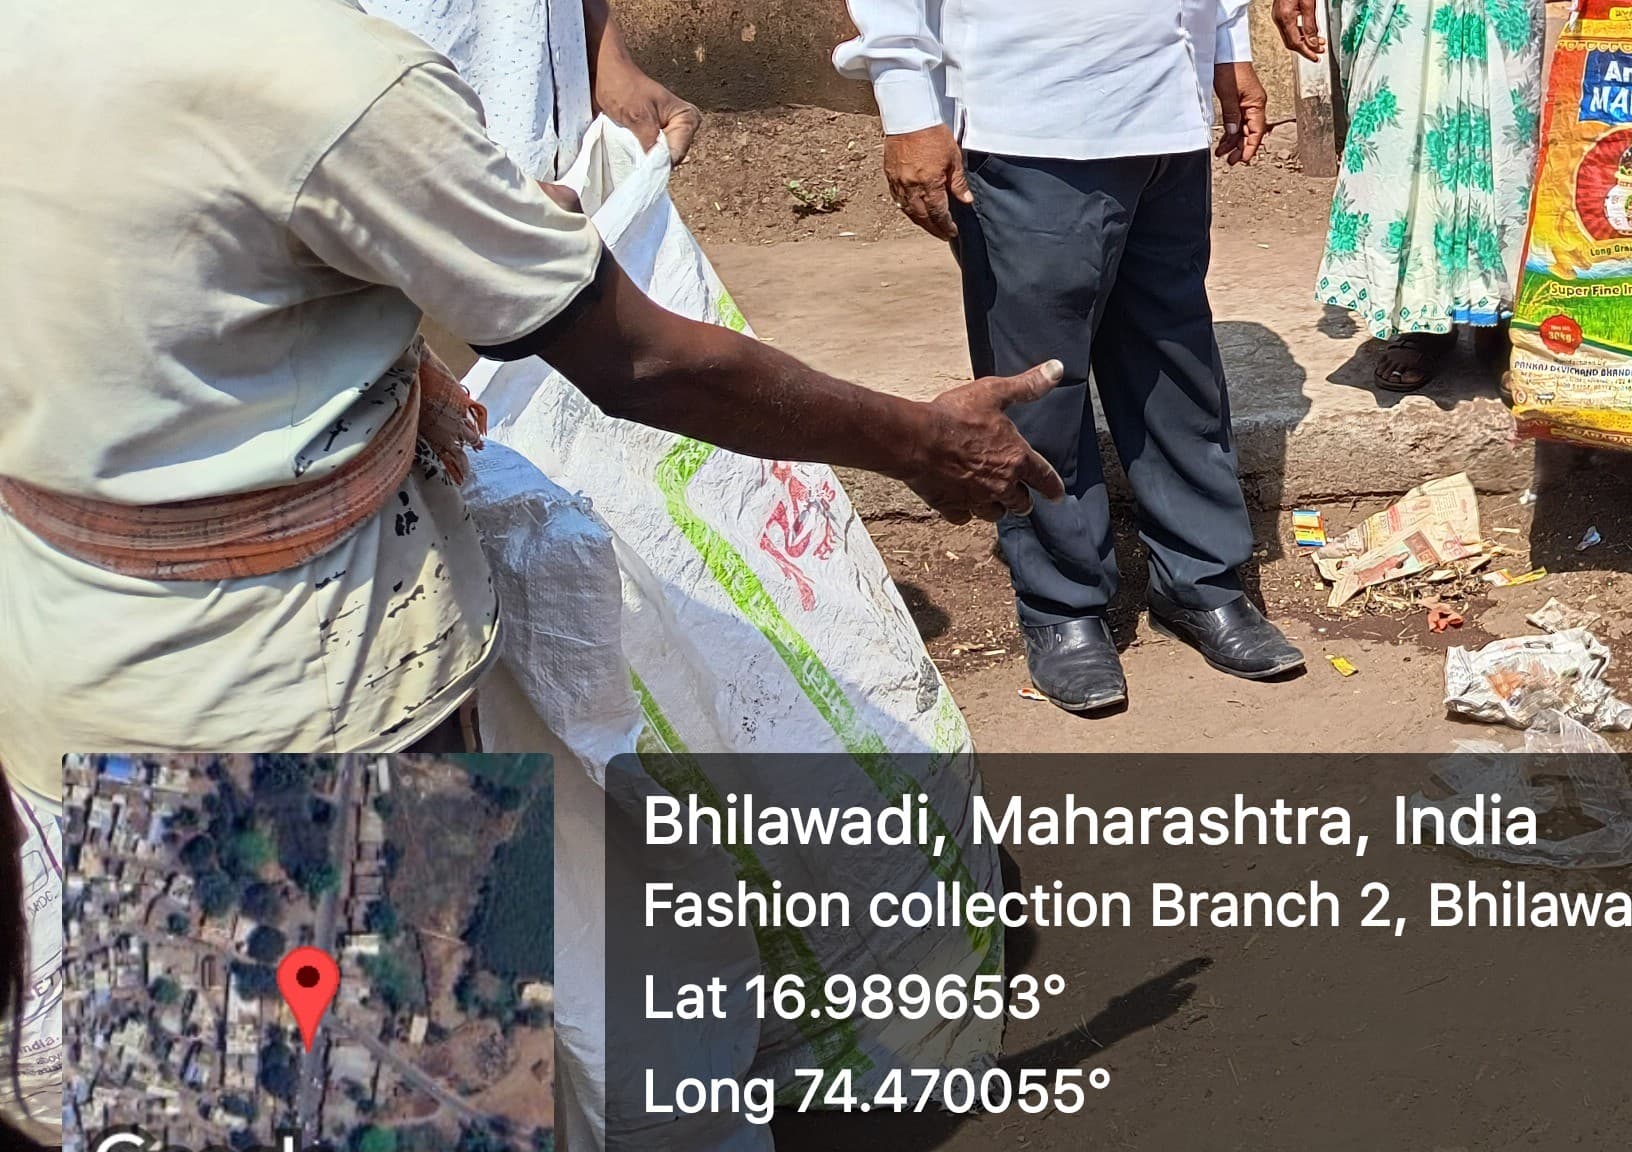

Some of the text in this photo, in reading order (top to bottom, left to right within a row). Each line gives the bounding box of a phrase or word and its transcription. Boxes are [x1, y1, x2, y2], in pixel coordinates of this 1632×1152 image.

[1590, 248, 1612, 258] Long
[1551, 283, 1589, 297] Super
[1591, 285, 1621, 296] Fine
